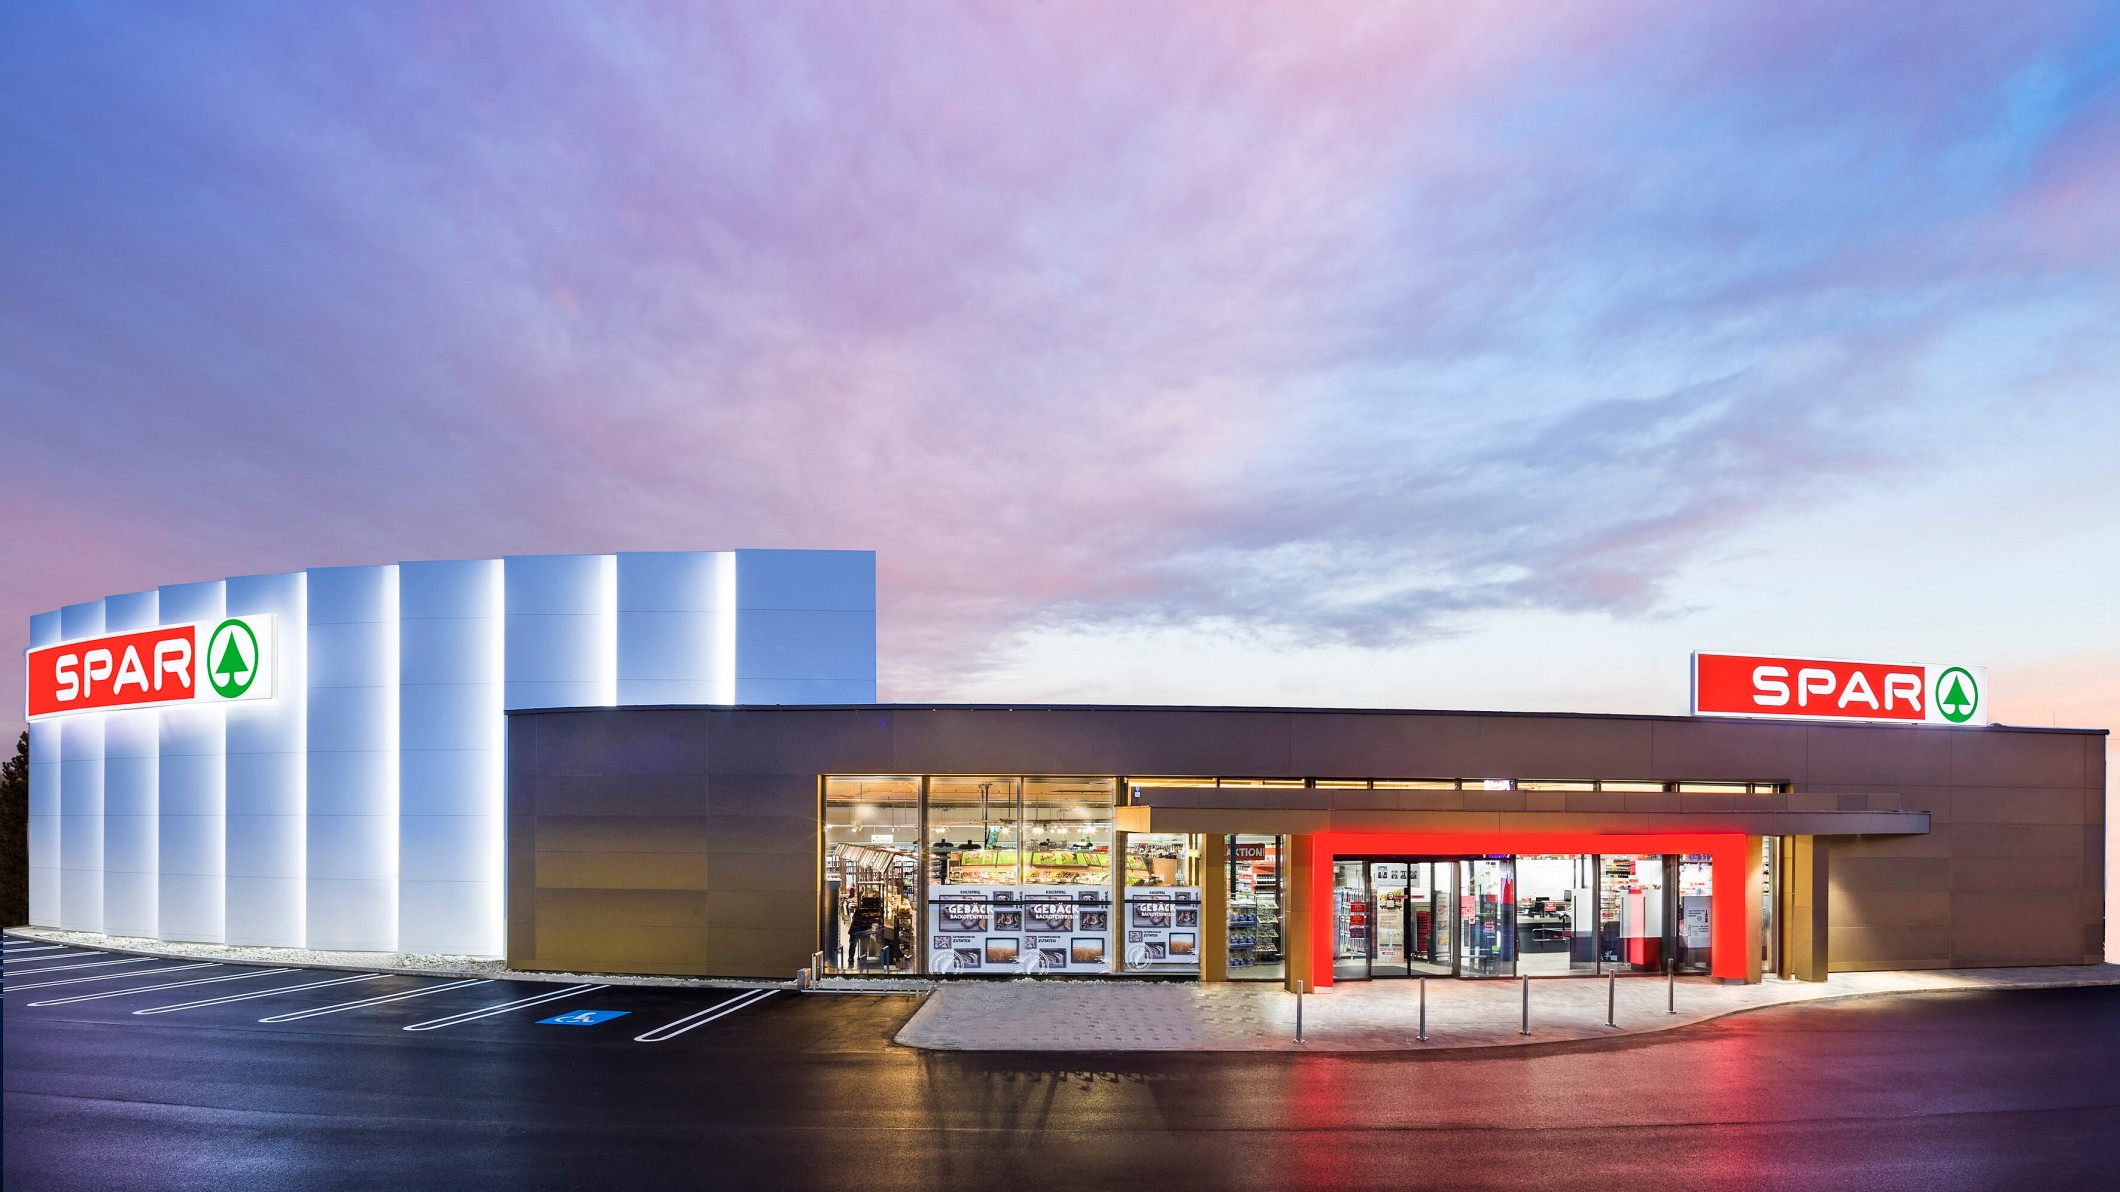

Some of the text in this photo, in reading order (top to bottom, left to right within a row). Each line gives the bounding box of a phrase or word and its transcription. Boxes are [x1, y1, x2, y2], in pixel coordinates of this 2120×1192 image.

[55, 637, 192, 702] SPAR
[1752, 665, 1922, 712] SPAR
[948, 902, 994, 914] GEBÄCK
[1033, 902, 1080, 914] GEBÄCK
[1140, 901, 1176, 912] GEBÄCK
